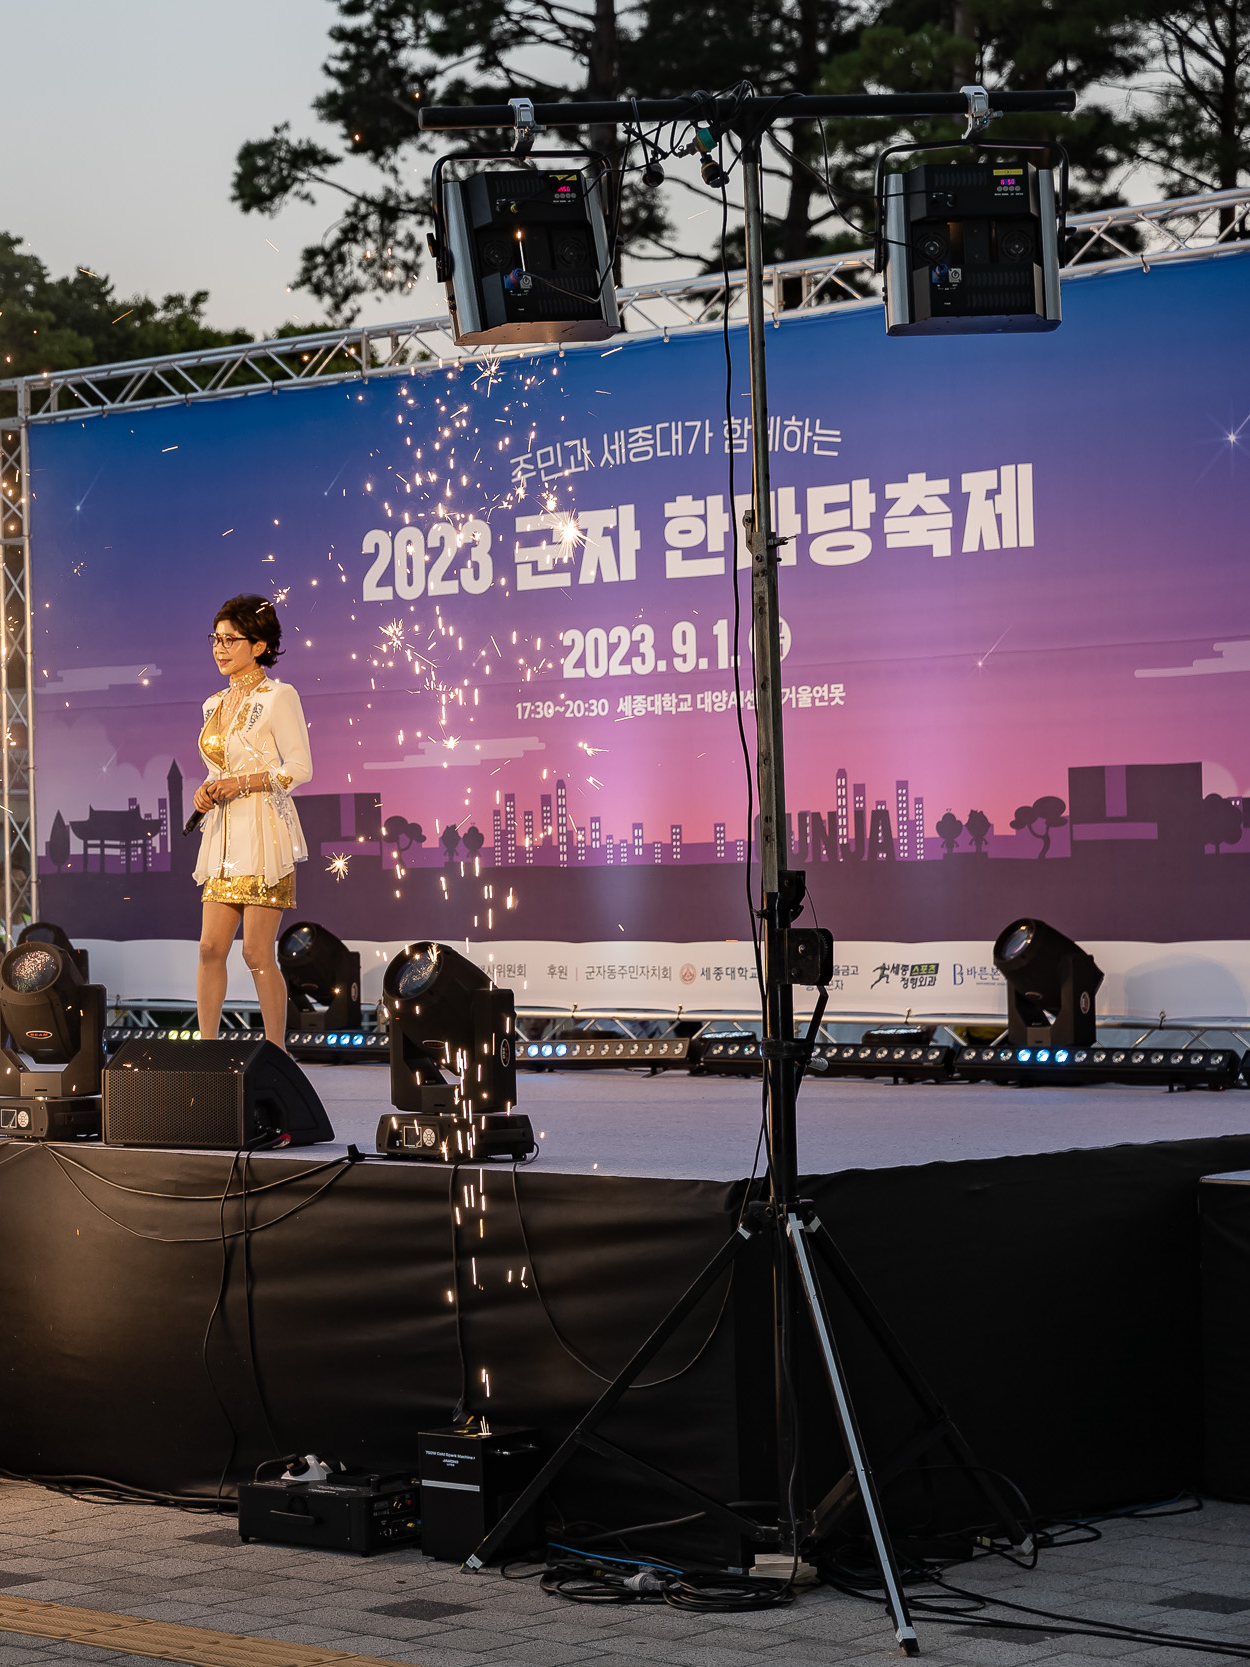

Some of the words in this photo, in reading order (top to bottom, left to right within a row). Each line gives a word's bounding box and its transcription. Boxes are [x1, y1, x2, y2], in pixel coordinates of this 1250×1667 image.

[510, 437, 591, 488] 주민과
[600, 419, 714, 467] 세종대가
[362, 519, 493, 602] 2023
[514, 504, 641, 591] 군자
[664, 463, 1033, 579] 한마당축제
[516, 699, 608, 720] 17:30~20:30
[617, 693, 693, 717] 세종대학교
[697, 689, 758, 714] 대양AI센
[781, 684, 846, 708] 거울연못
[547, 964, 568, 981] 후원
[585, 964, 672, 981] 군자동주민자치회
[700, 966, 760, 981] 세종대학교
[890, 963, 910, 976] 세종
[966, 965, 1006, 981] 바른본
[900, 975, 937, 990] 정형외과
